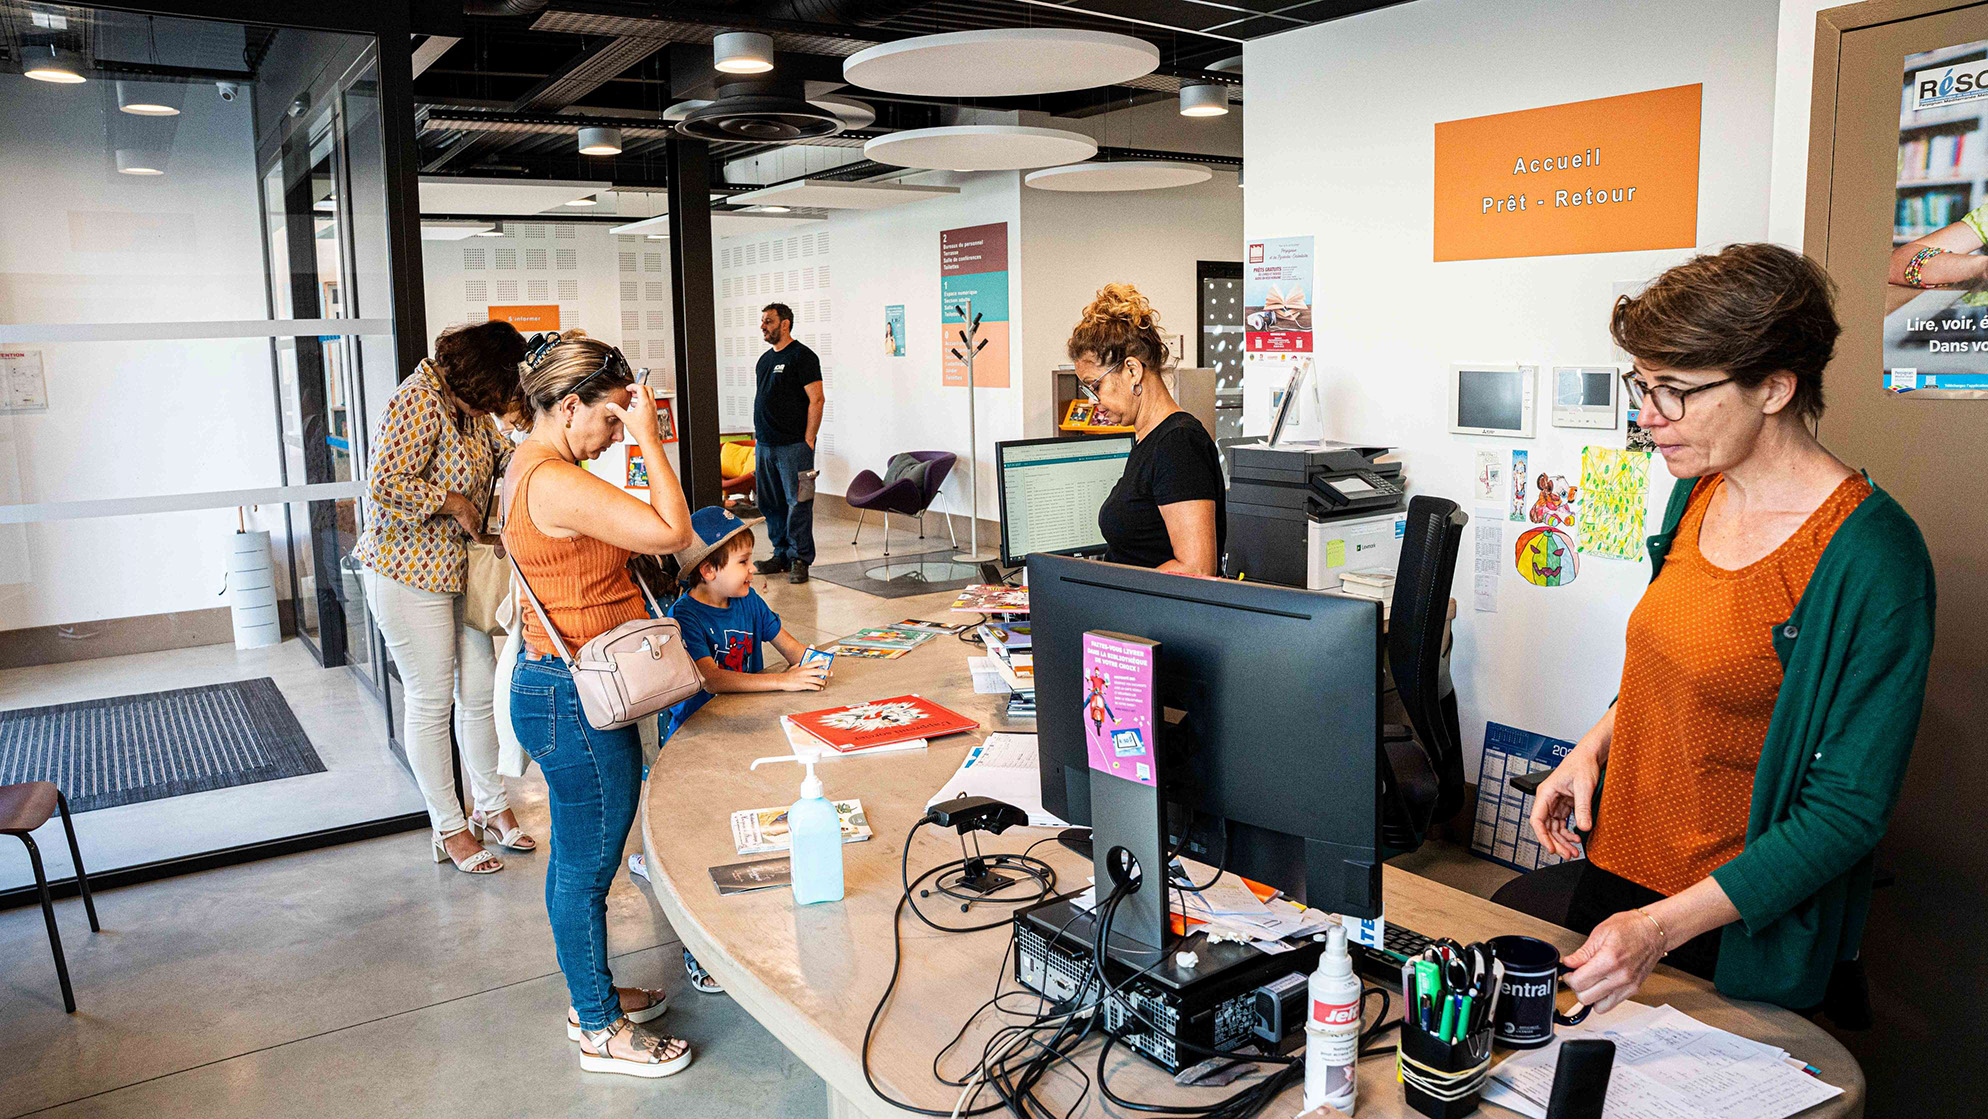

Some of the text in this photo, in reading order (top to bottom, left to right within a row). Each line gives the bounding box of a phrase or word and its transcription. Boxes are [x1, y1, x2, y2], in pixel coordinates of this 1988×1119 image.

[1513, 147, 1601, 175] Accueil
[1482, 193, 1527, 214] Prêt
[1555, 187, 1637, 208] Retour
[943, 233, 948, 243] 2
[944, 281, 948, 290] 1
[1907, 317, 1939, 332] Lire,
[1942, 315, 1976, 331] voir,
[1929, 340, 1969, 352] Dans
